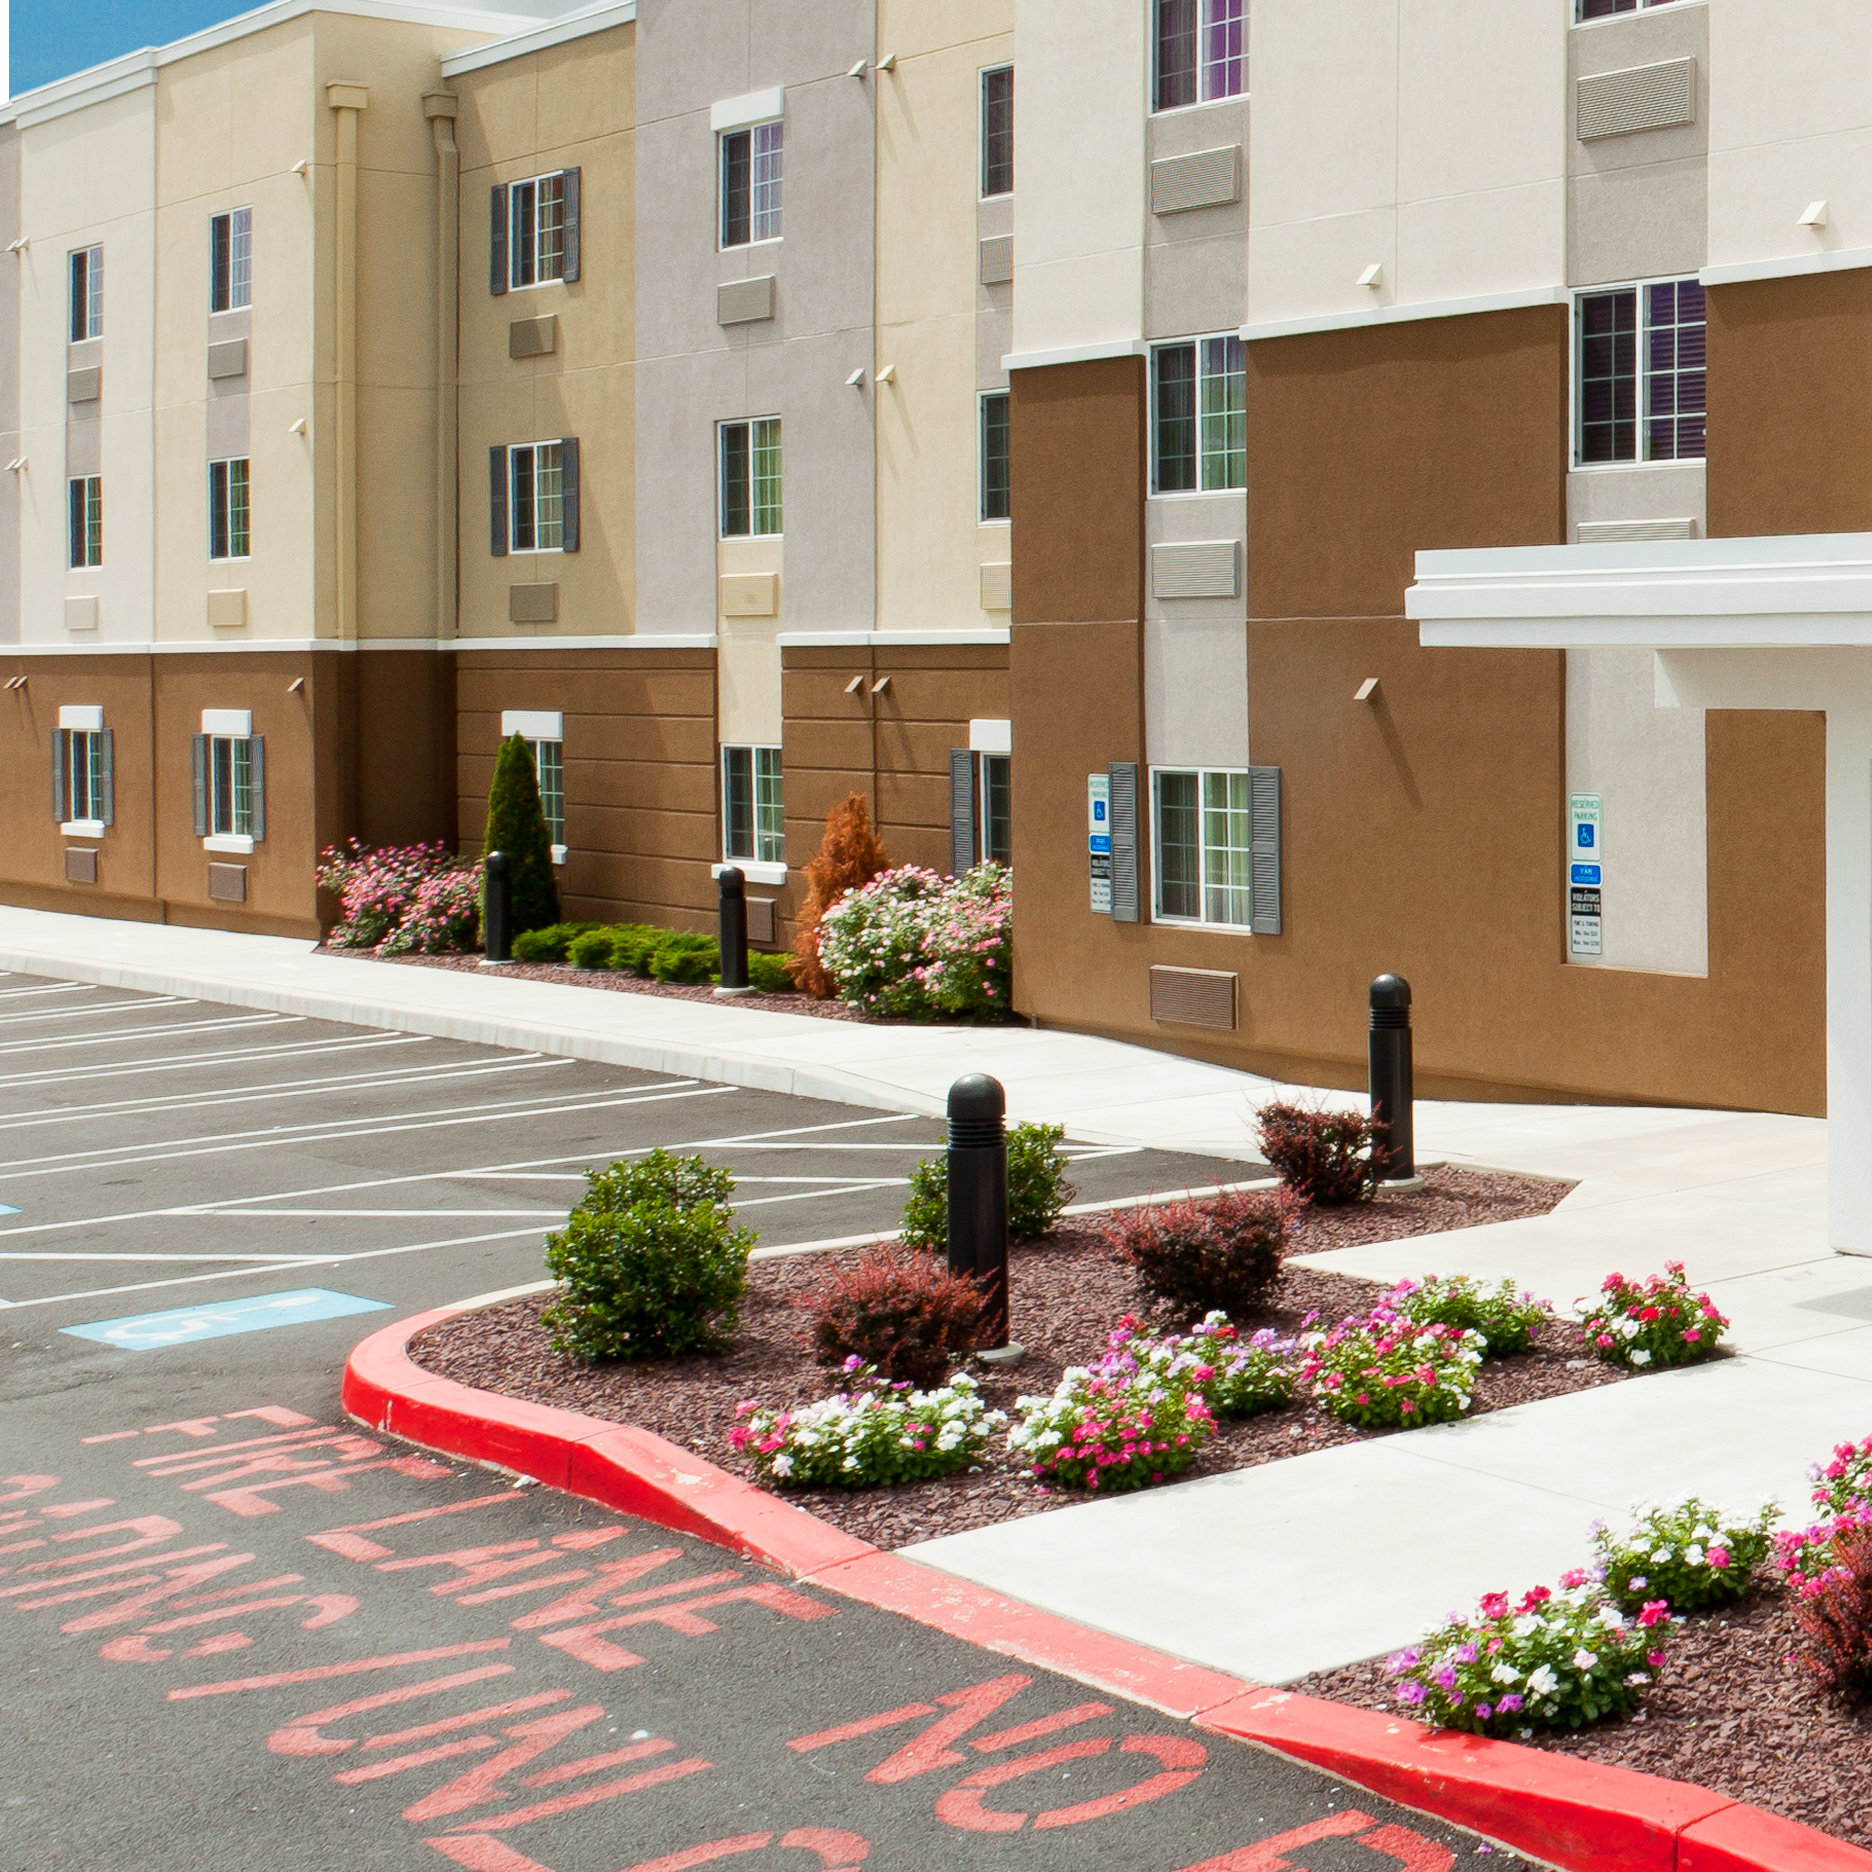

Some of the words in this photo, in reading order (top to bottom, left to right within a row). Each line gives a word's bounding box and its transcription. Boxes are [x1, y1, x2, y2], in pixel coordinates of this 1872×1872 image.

[80, 1403, 454, 1518] FIRE
[304, 1489, 841, 1673] LANE
[785, 1672, 1208, 1832] NO
